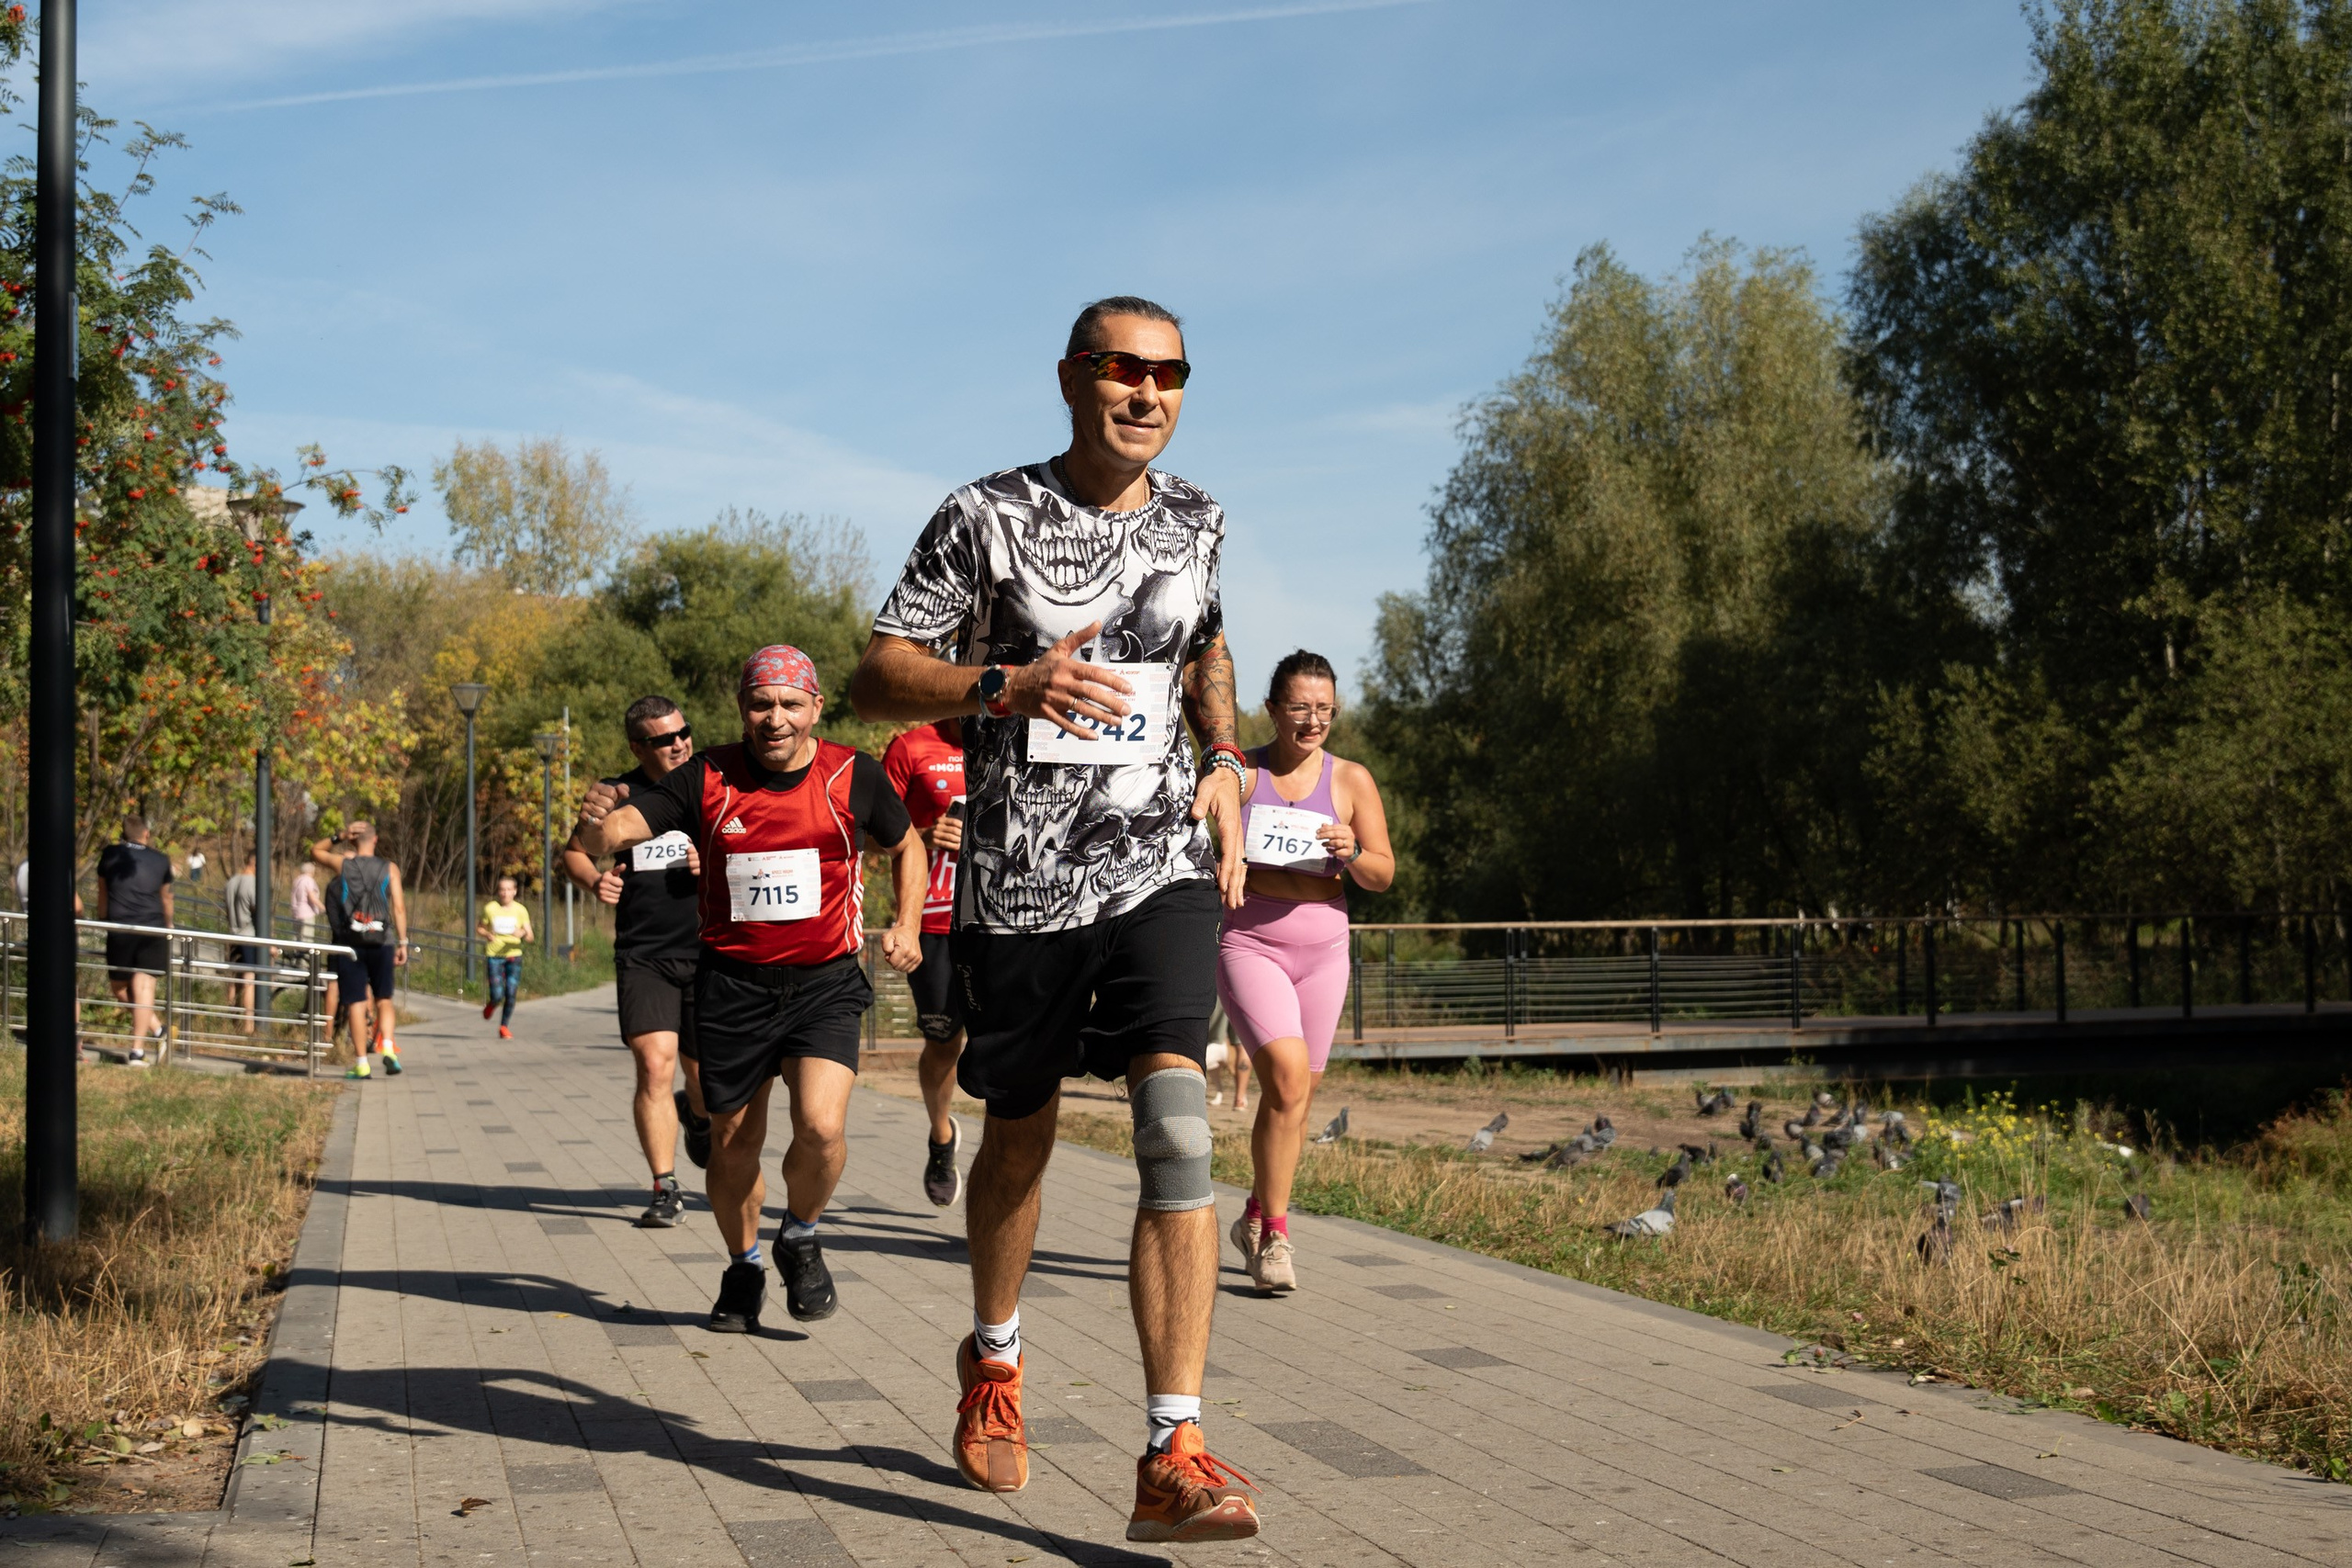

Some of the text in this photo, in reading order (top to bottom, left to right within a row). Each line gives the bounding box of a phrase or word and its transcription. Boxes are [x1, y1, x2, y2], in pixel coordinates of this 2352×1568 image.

[644, 843, 687, 860] 7265
[1262, 834, 1313, 856] 7167
[749, 885, 799, 906] 7115
